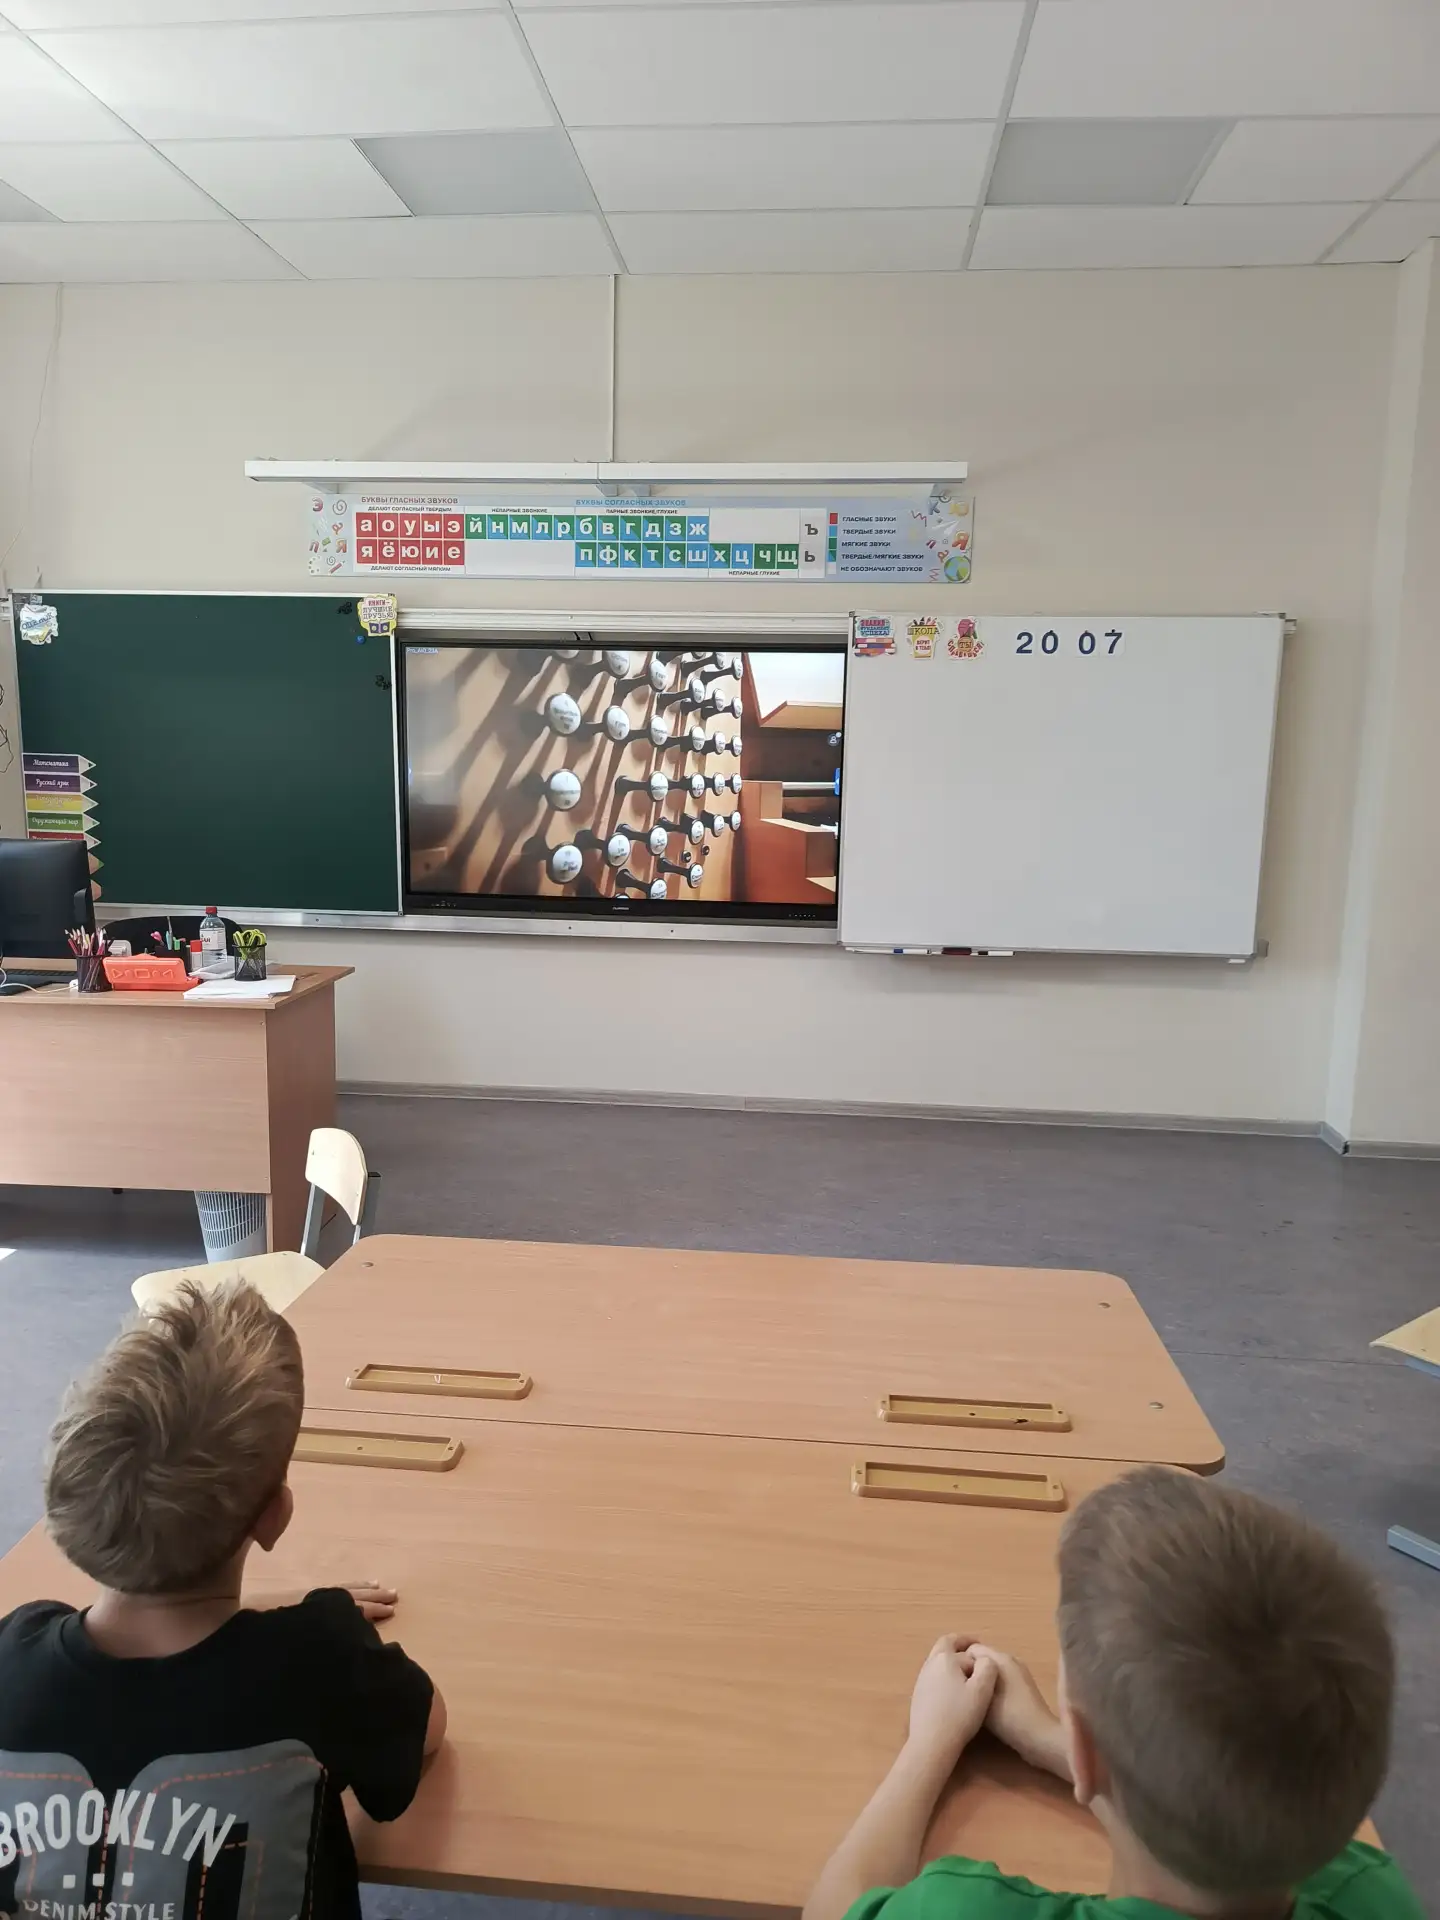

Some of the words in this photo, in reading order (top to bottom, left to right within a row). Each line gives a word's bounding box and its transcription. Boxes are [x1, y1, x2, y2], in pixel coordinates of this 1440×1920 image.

[389, 496, 426, 504] ГЛАСНЫХ
[1016, 631, 1059, 654] 20
[1079, 631, 1122, 655] 07
[36, 778, 56, 787] Русский
[0, 1788, 237, 1868] BROOKLYN
[104, 1902, 175, 1920] STYLE
